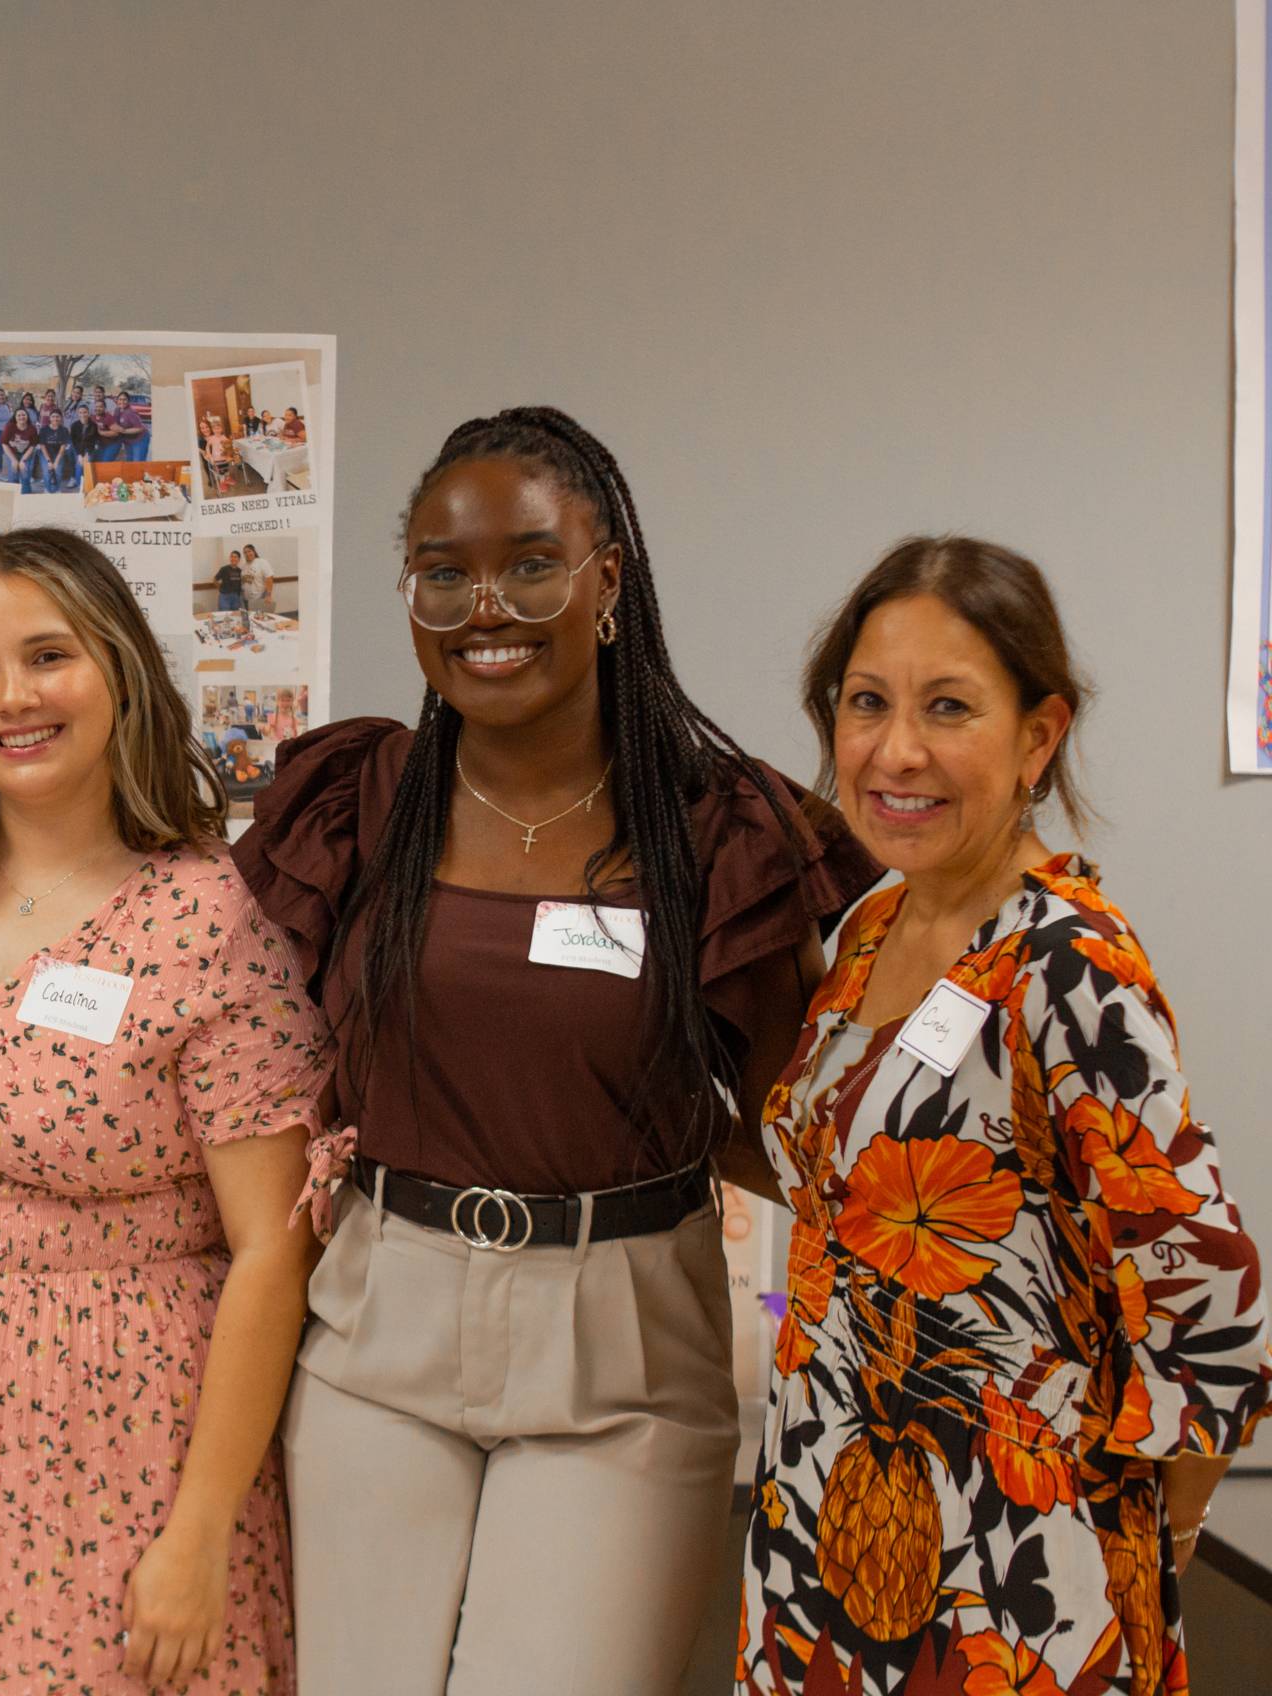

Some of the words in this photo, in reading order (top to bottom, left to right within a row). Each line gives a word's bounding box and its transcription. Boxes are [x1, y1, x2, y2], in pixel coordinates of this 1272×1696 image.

[200, 502, 236, 516] BEARS
[241, 499, 270, 511] NEED
[275, 494, 317, 508] VITALS
[230, 519, 291, 534] CHECKED!!
[82, 530, 126, 545] BEAR
[131, 531, 192, 546] CLINIC
[42, 982, 98, 1011] Catalina
